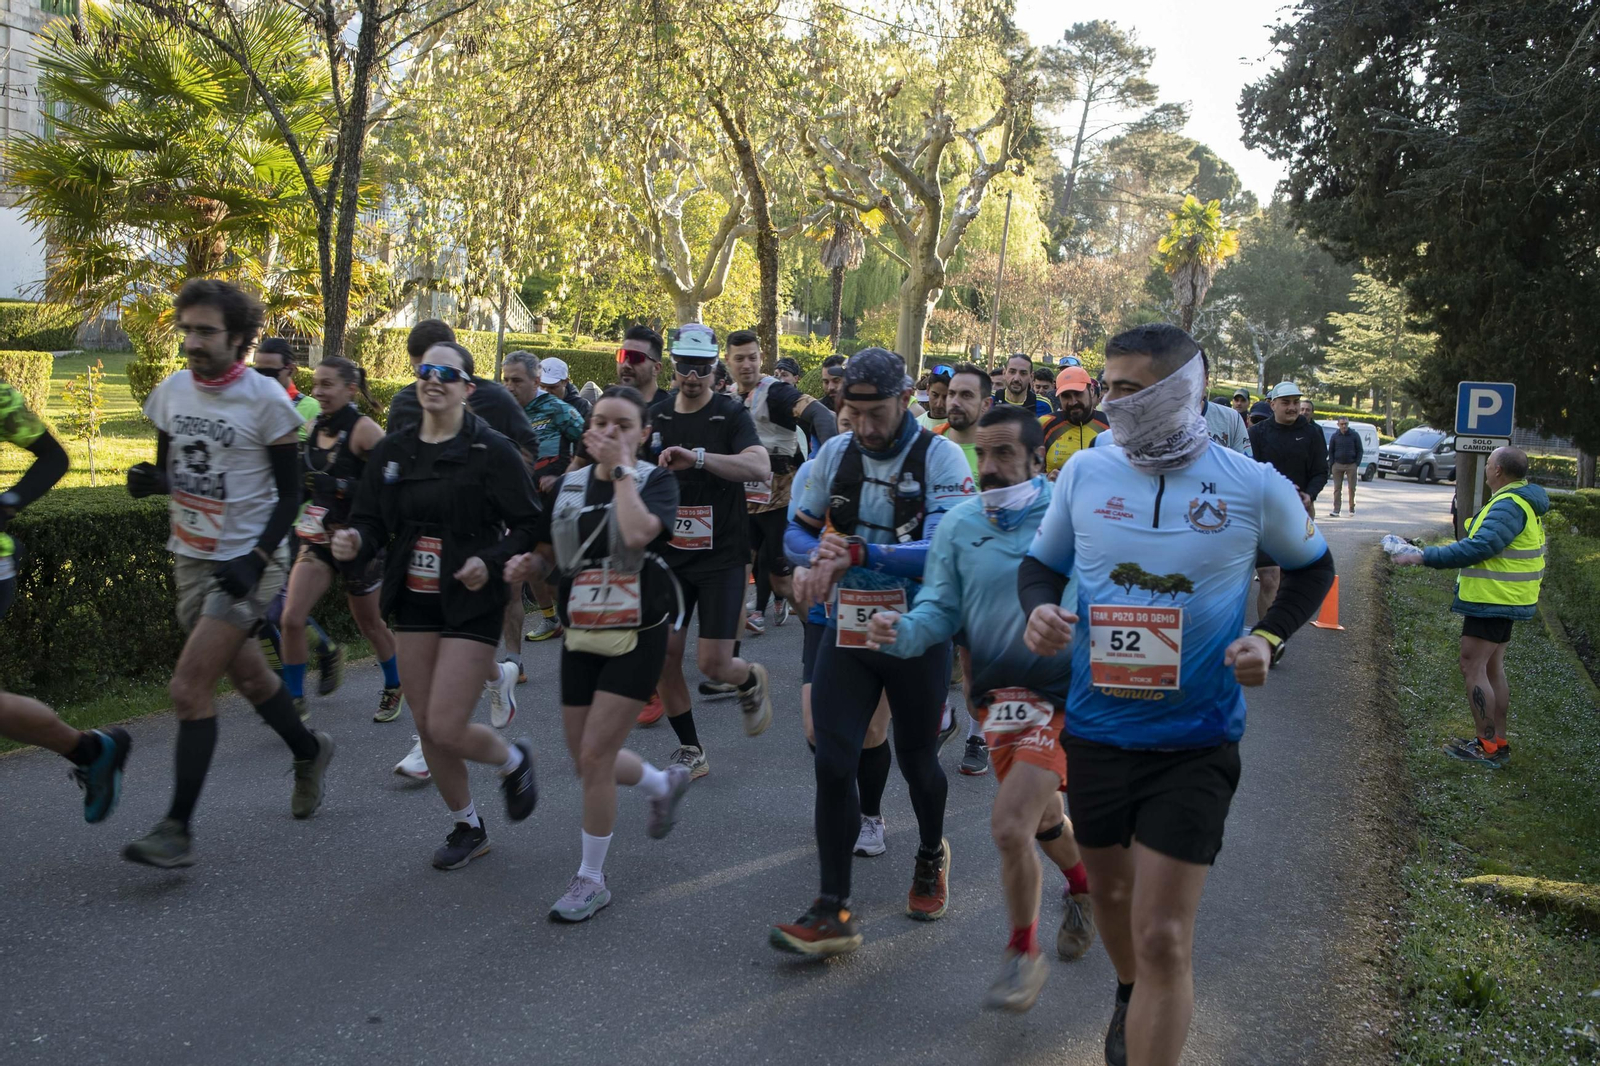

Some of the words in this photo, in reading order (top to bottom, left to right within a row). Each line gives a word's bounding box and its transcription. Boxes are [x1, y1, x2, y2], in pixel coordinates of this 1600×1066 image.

[1467, 388, 1503, 429] P
[1462, 444, 1501, 452] CAMIONE
[1472, 438, 1493, 446] SOLO
[675, 519, 692, 531] 79
[1112, 611, 1135, 622] POZO
[1136, 612, 1149, 623] DO
[1151, 613, 1176, 624] DEMO
[1110, 630, 1141, 652] 52
